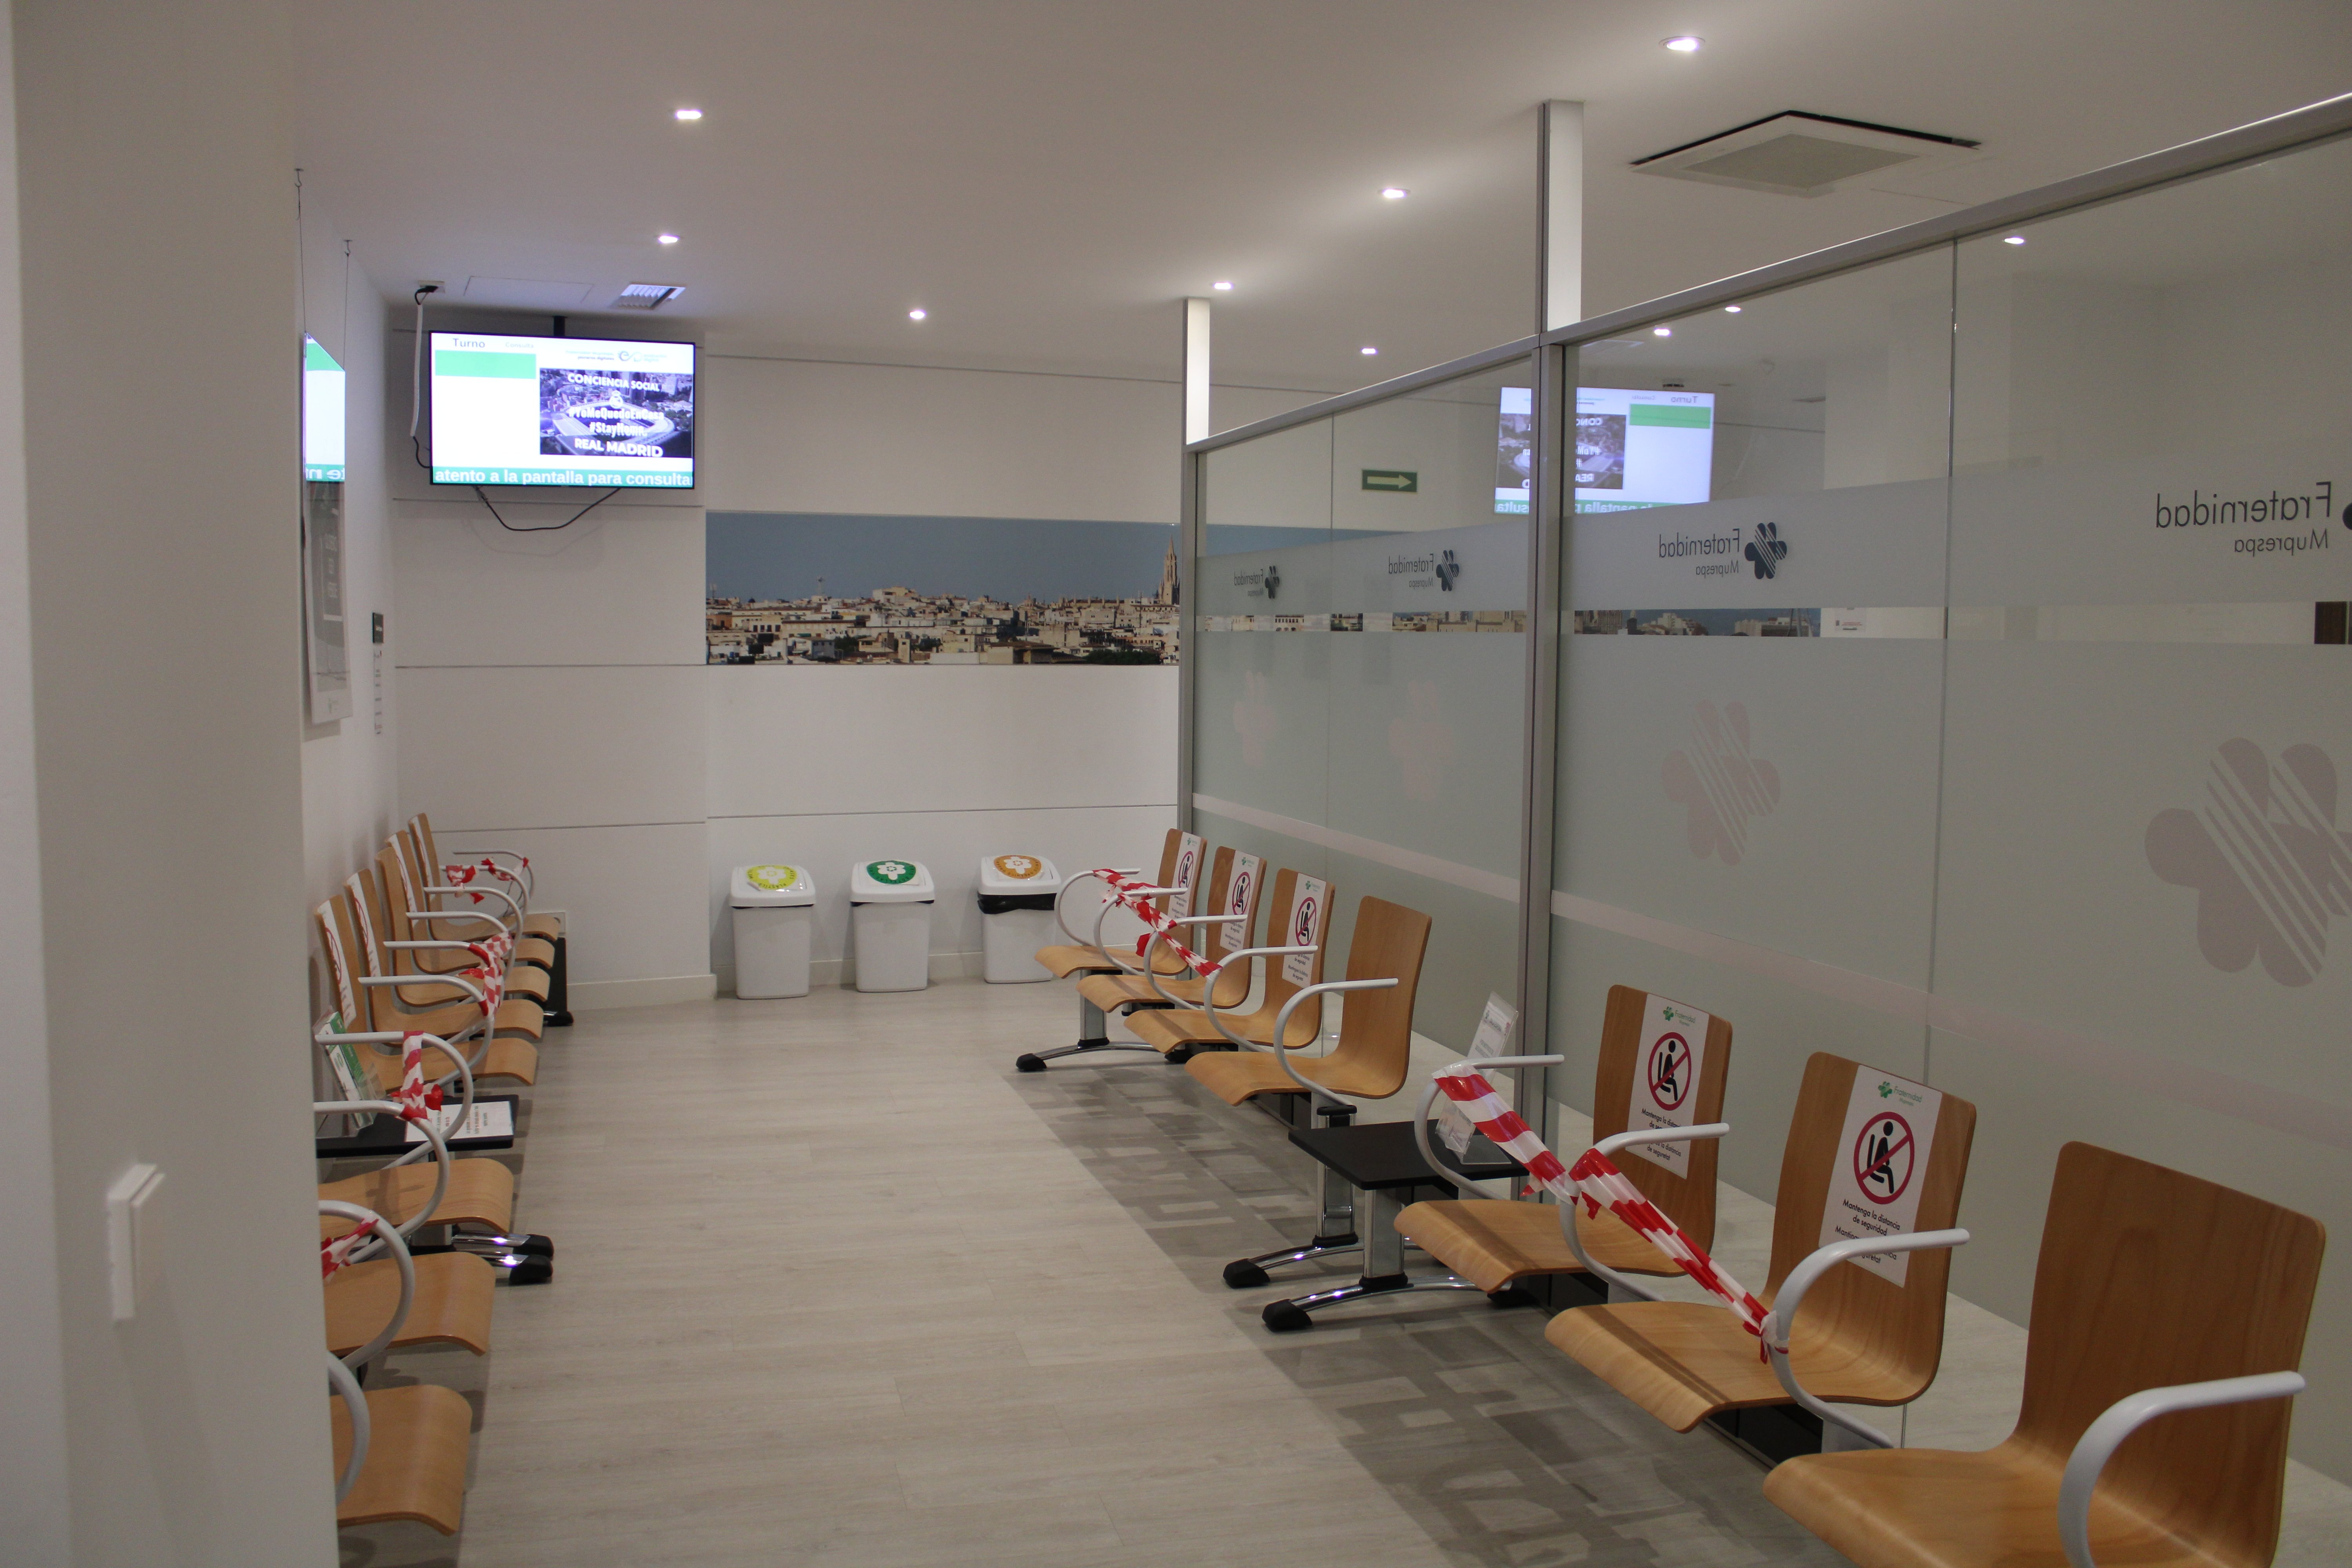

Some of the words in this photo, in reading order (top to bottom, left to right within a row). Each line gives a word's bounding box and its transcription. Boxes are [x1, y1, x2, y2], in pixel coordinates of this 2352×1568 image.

[453, 338, 485, 348] Turno
[568, 373, 630, 388] CONCIENCIA
[631, 380, 660, 392] SOCIAL
[568, 407, 664, 420] #YoMeQuedoEnCasa
[574, 438, 604, 452] REAL
[606, 441, 664, 457] MADRID
[435, 469, 486, 482] atento
[490, 472, 500, 483] a
[504, 469, 519, 483] la
[523, 470, 584, 485] pantalla
[588, 473, 622, 486] para
[1641, 1107, 1662, 1122] Mantenga
[1662, 1116, 1667, 1124] la
[1653, 1149, 1670, 1161] seguretat
[1843, 1199, 1871, 1217] Mantenga
[1871, 1210, 1877, 1220] la
[1878, 1214, 1901, 1230] distancia
[1853, 1214, 1860, 1224] de
[1861, 1220, 1888, 1236] seguridad
